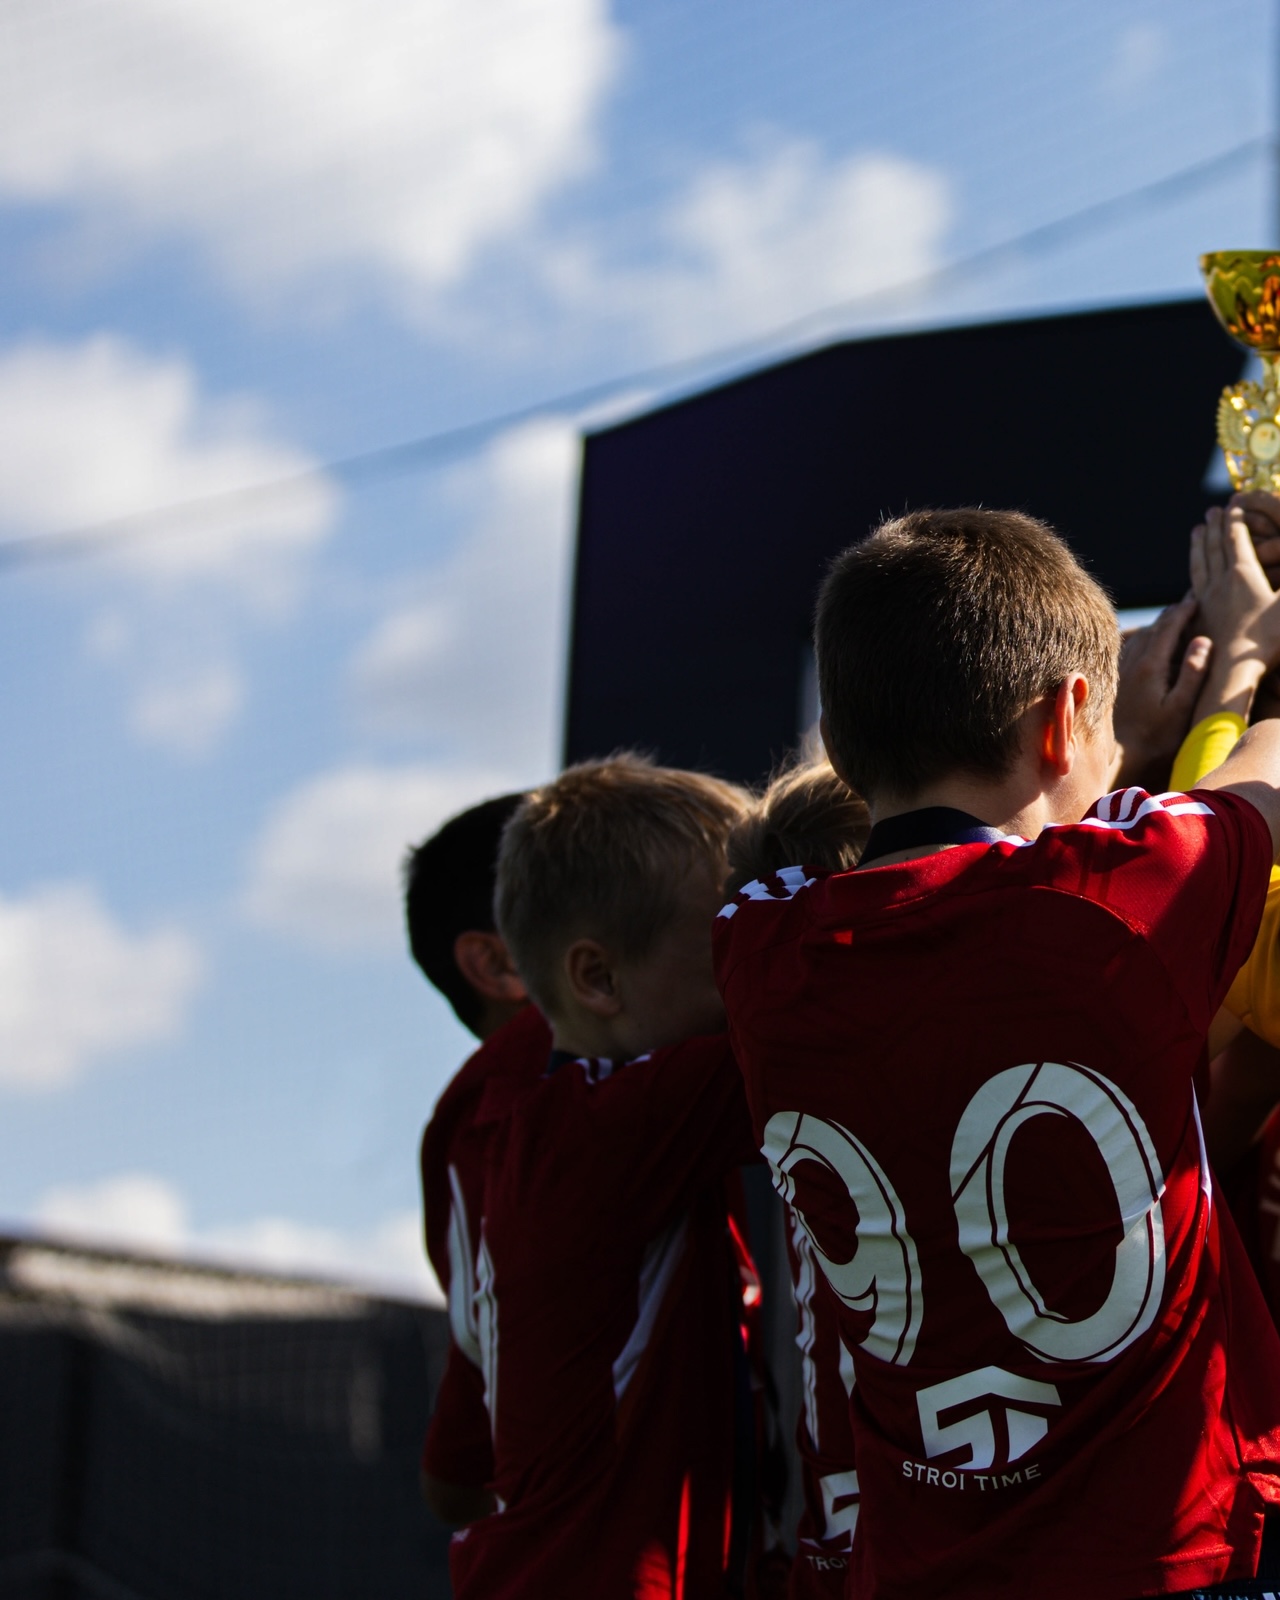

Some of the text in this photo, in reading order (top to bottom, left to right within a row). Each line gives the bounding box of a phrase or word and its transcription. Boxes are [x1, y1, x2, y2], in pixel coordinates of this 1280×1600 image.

[761, 1062, 1167, 1366] 90
[901, 1460, 1042, 1491] STROI TIME
